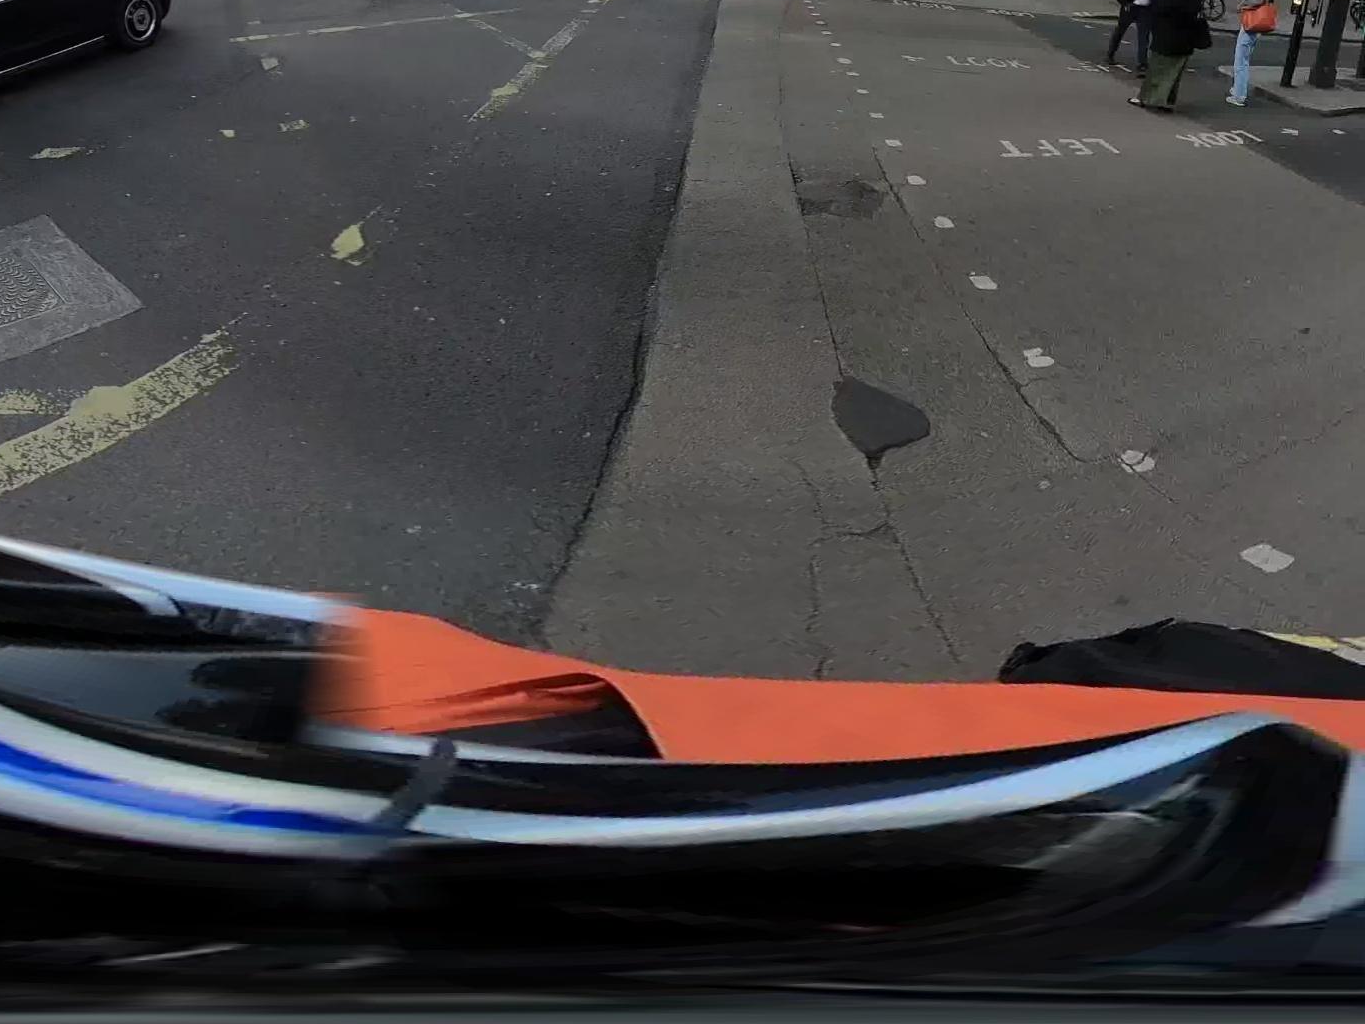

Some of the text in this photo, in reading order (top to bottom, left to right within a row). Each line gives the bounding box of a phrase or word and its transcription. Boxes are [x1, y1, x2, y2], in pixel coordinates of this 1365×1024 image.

[946, 55, 1031, 70] LOOK
[998, 129, 1264, 158] LOOK LEFT
